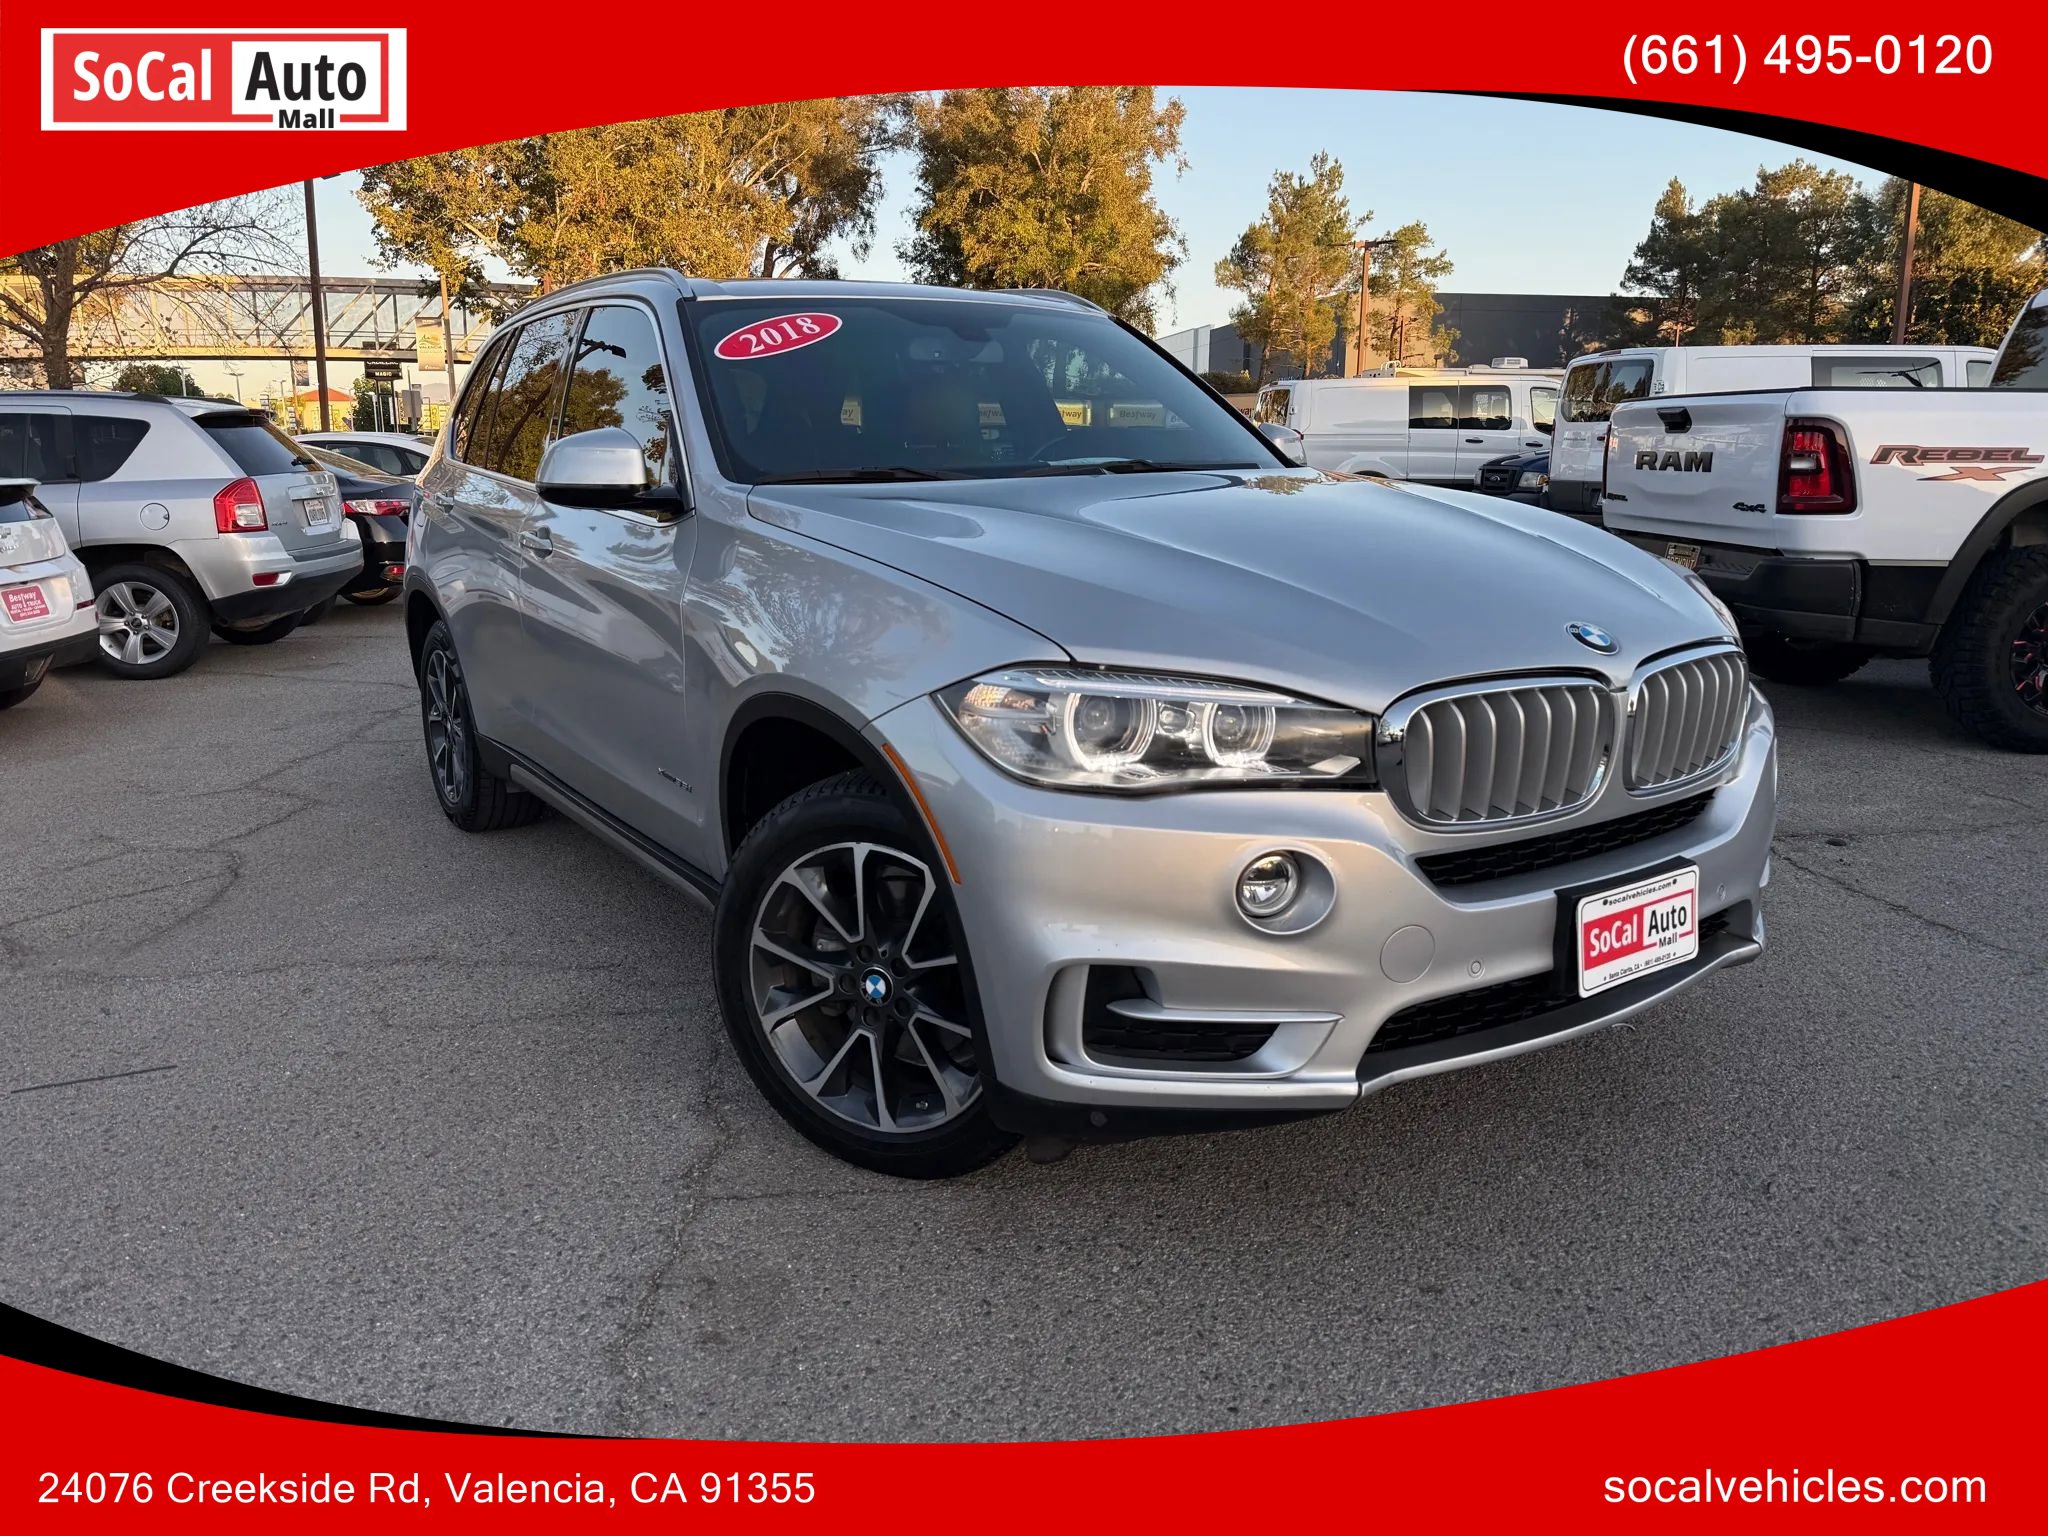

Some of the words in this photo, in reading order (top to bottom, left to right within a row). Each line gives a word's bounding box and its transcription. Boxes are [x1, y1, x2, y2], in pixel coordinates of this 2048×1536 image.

[739, 317, 821, 354] 2018
[1635, 450, 1714, 473] RAM
[1869, 444, 2046, 466] REBEL
[1916, 466, 2037, 482] X
[1608, 881, 1672, 906] socalvehicles.com
[1589, 913, 1638, 958] SoCal
[1647, 904, 1687, 938] Auto
[1659, 932, 1678, 948] Mall
